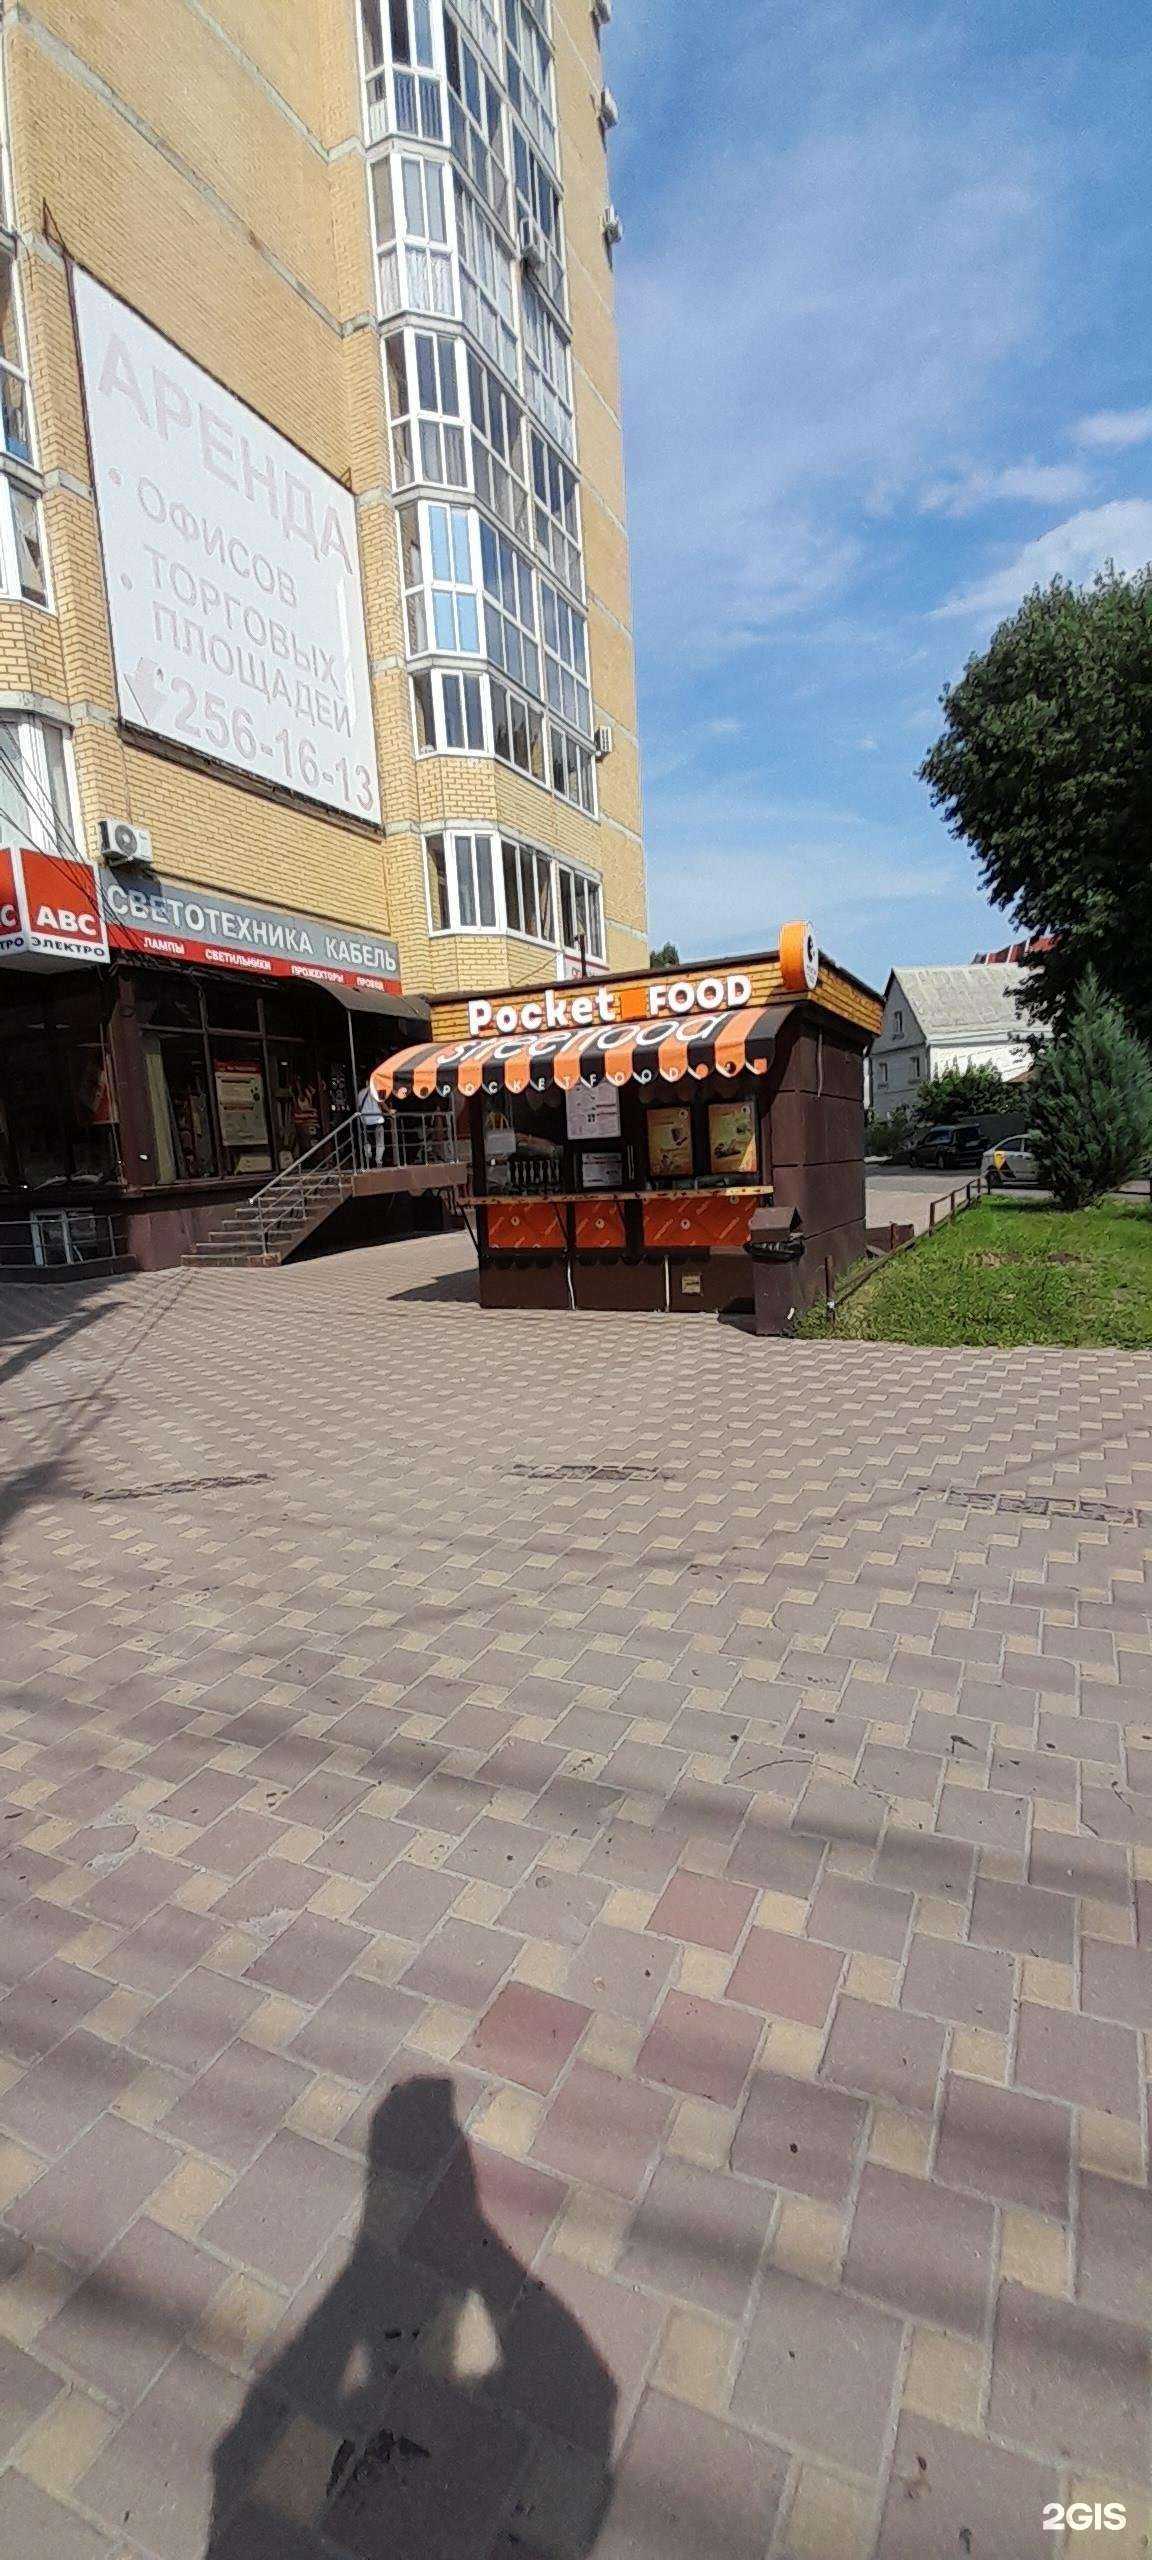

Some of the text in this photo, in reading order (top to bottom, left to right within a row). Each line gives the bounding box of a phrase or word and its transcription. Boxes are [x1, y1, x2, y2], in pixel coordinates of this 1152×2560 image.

[98, 334, 354, 575] АРЕНДА
[138, 476, 297, 608] ОФИСОВ
[144, 544, 343, 699] ТОРГОВЫХ
[152, 600, 352, 738] ПЛОЩАДЕЙ
[171, 676, 373, 811] 256-16-13
[31, 936, 105, 957] ЭЛЕКТРО
[106, 884, 397, 972] СВЕТОТЕХНИКА КАБЕЛЬ
[143, 937, 186, 955] ЛАМПЫ
[468, 974, 752, 1037] Pocket FOOD
